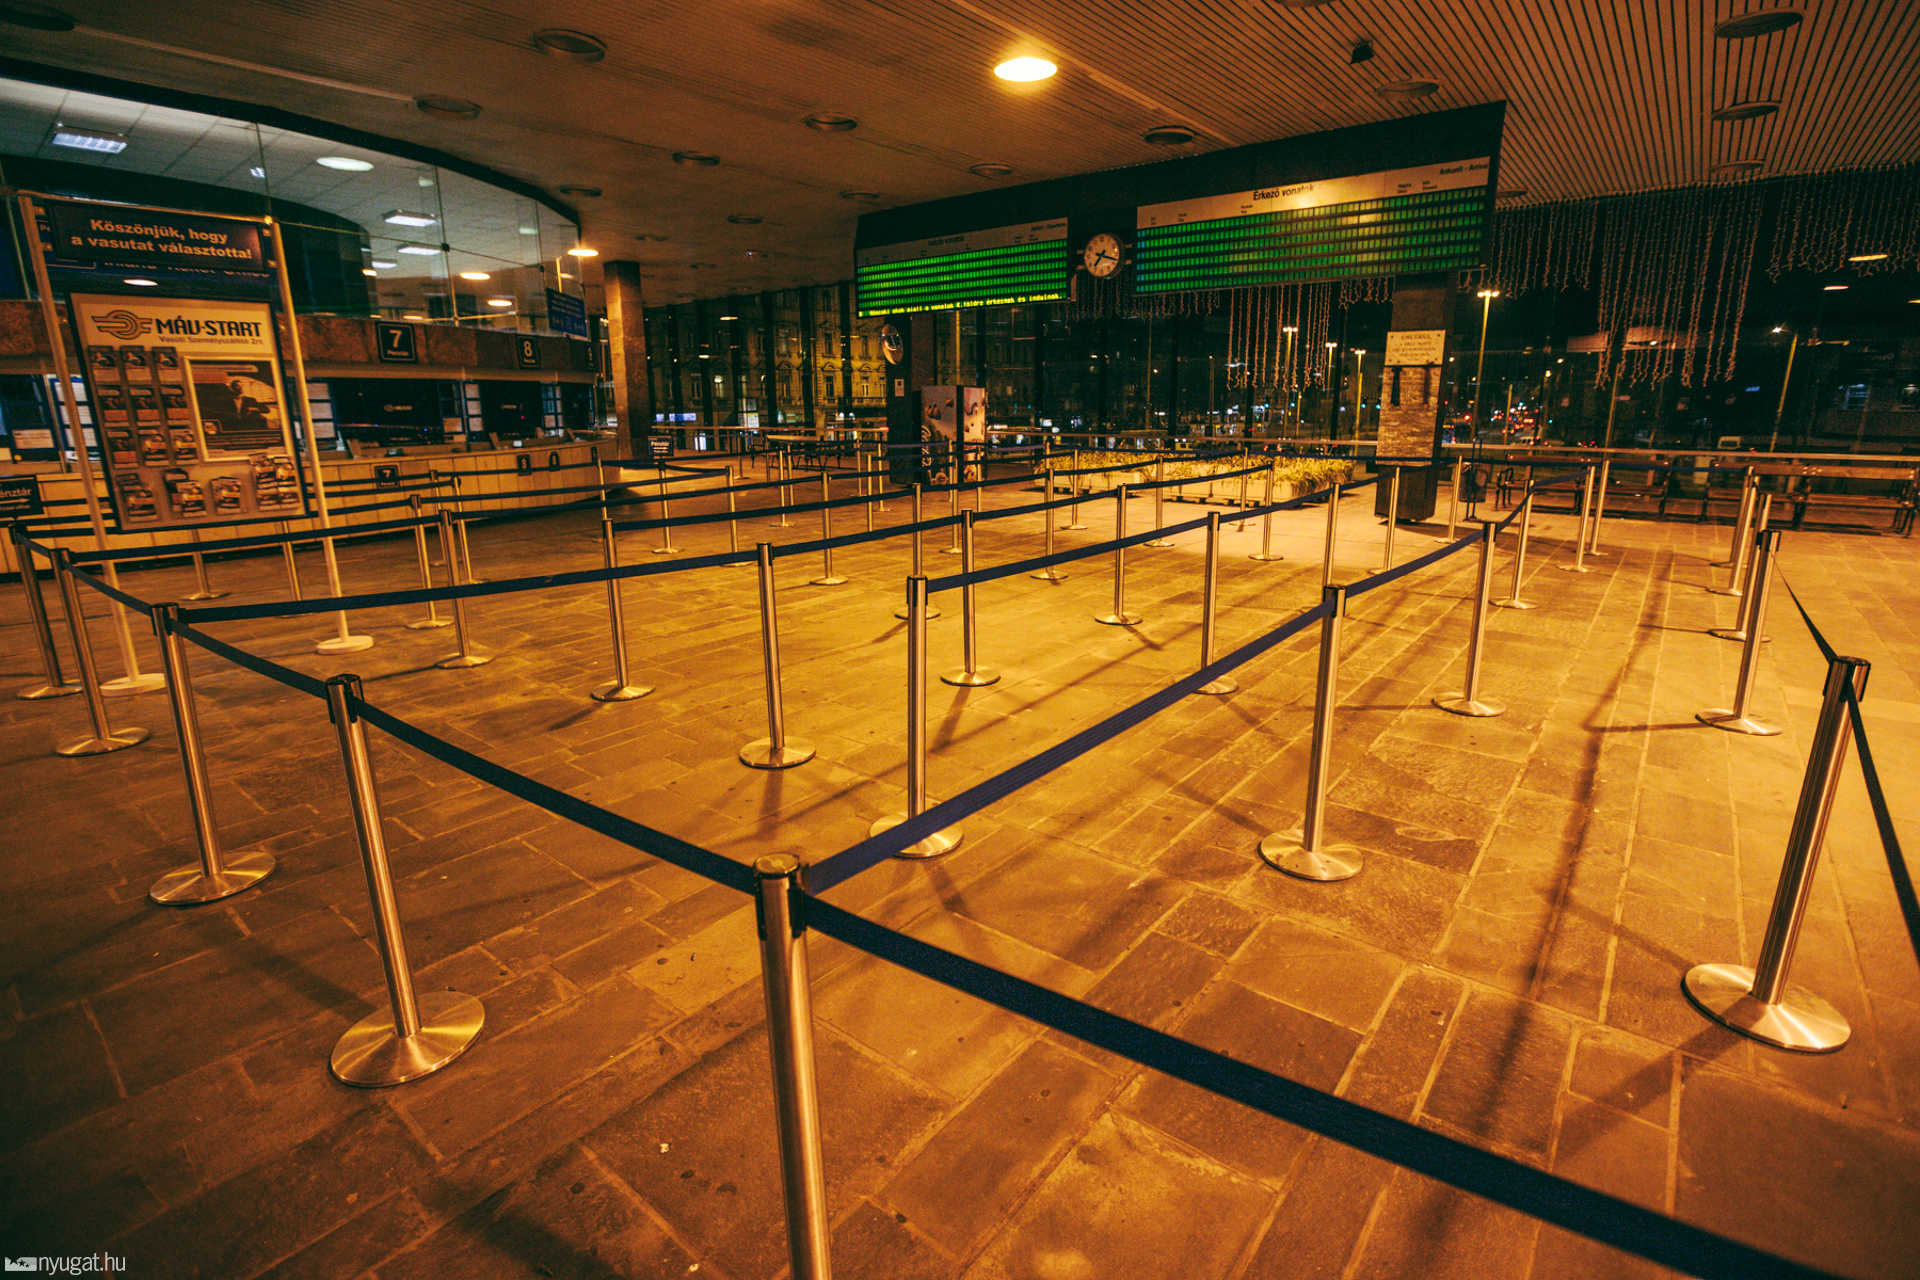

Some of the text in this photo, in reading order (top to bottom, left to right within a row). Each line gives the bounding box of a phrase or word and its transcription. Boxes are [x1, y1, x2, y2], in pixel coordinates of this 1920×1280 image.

[90, 218, 228, 245] Köszönjük, hogy
[71, 235, 253, 260] a vasutat választotta!
[389, 329, 402, 348] 7
[523, 340, 533, 357] 8
